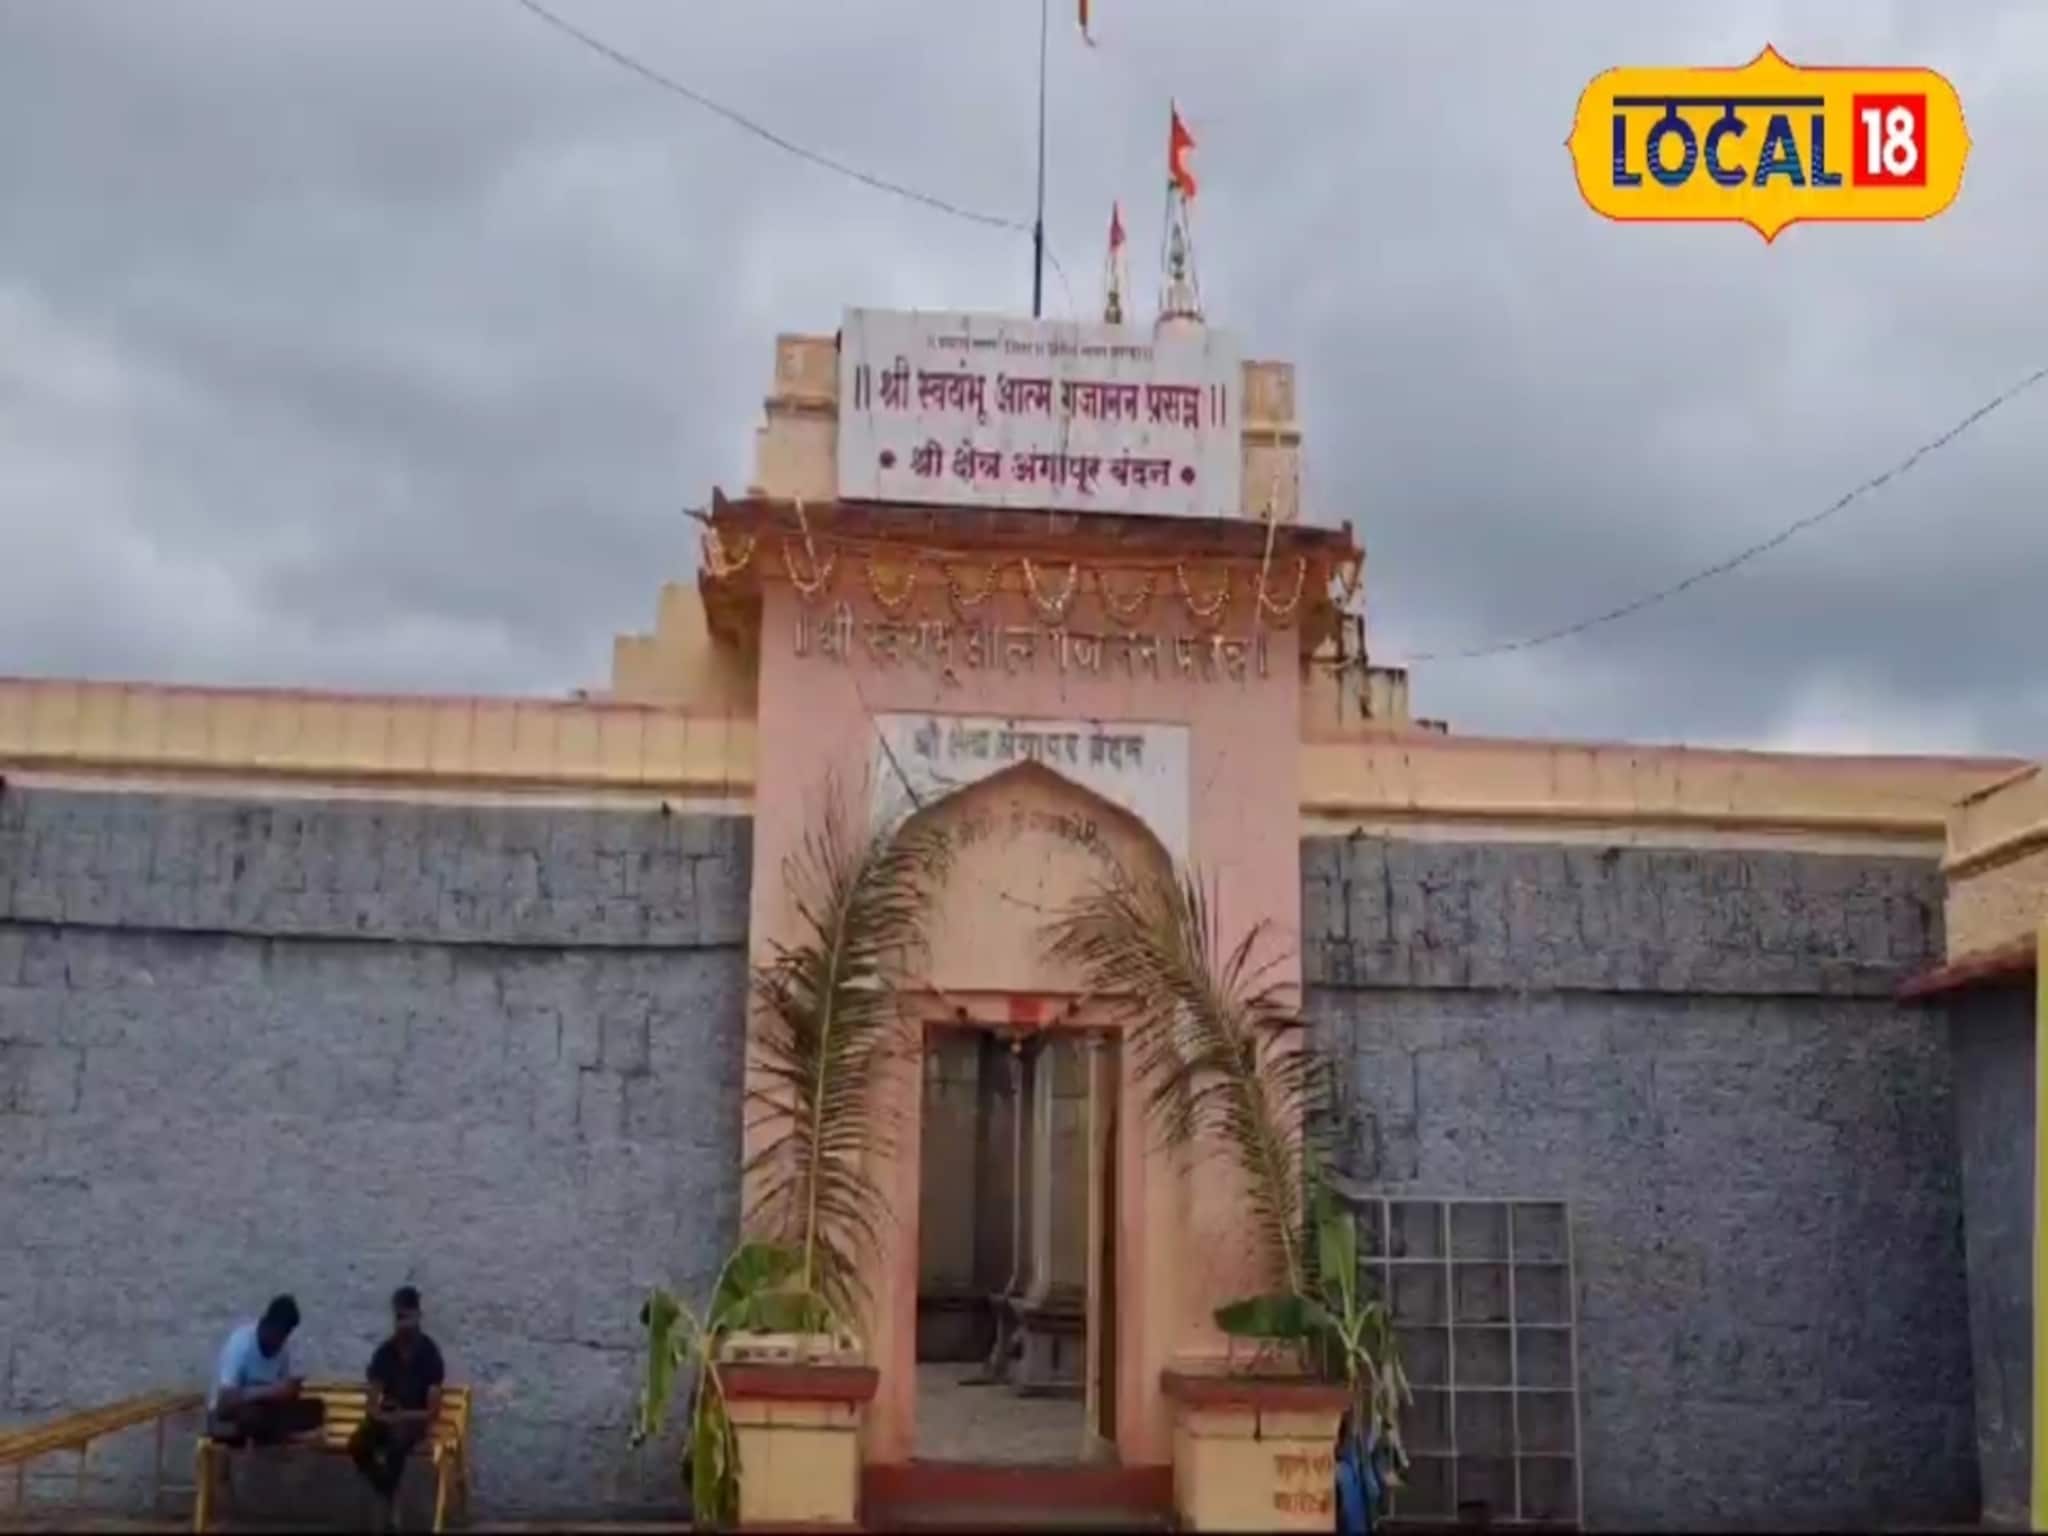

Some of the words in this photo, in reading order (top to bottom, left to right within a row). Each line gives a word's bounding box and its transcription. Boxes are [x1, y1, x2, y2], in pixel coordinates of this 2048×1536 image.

[880, 355, 910, 410] श्री
[917, 359, 987, 426] स्वयंभू
[997, 372, 1053, 419] आत्म
[910, 437, 943, 479] श्री
[953, 437, 1002, 483] क्षेत्र
